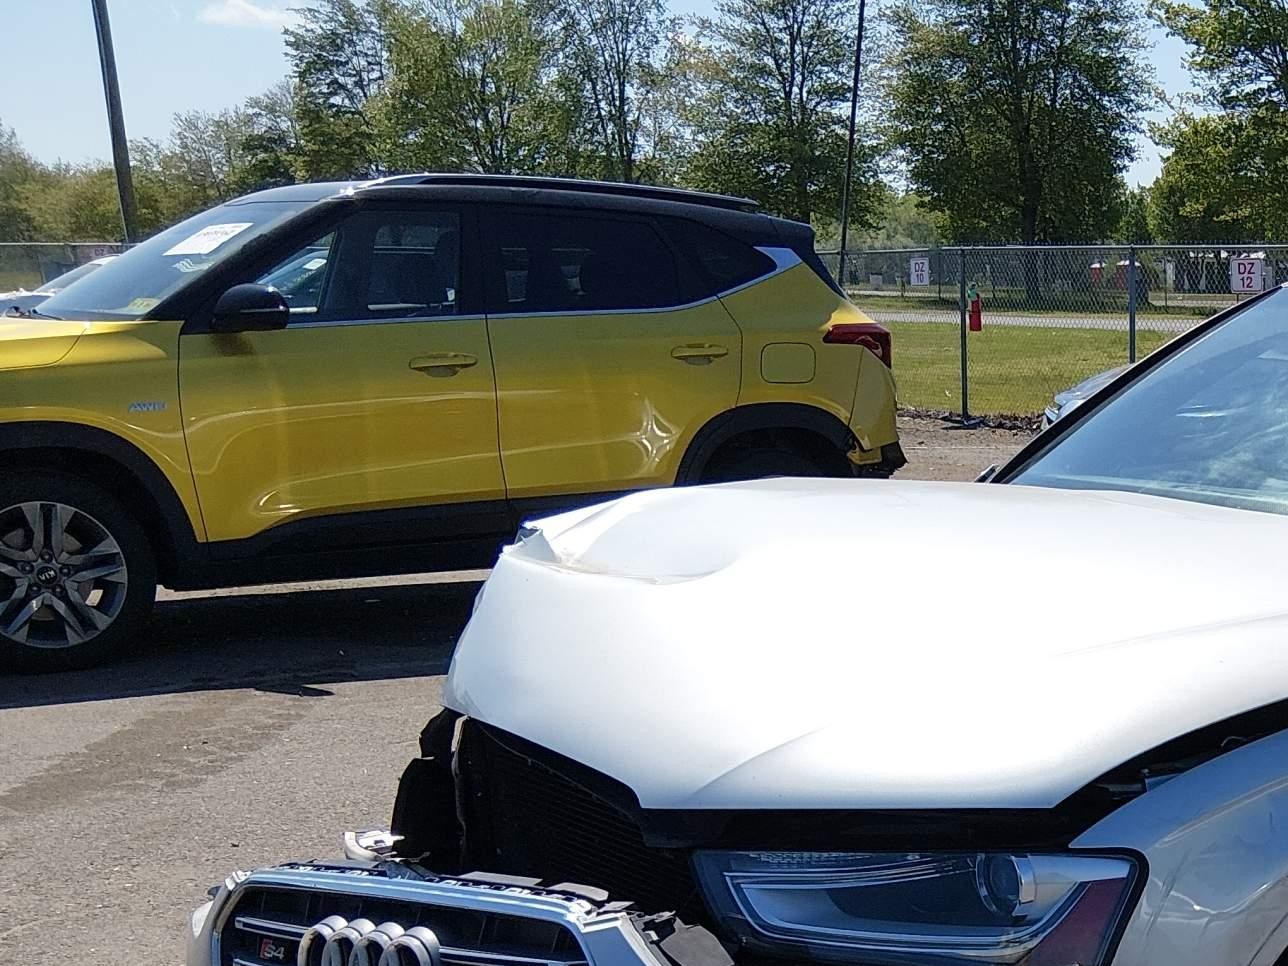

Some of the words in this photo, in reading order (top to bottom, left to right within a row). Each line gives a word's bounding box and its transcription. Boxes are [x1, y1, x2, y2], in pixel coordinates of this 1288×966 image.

[914, 262, 926, 273] DZ
[1237, 262, 1256, 275] DZ
[916, 273, 925, 283] 10
[1239, 276, 1254, 289] 12
[264, 943, 285, 960] S4
